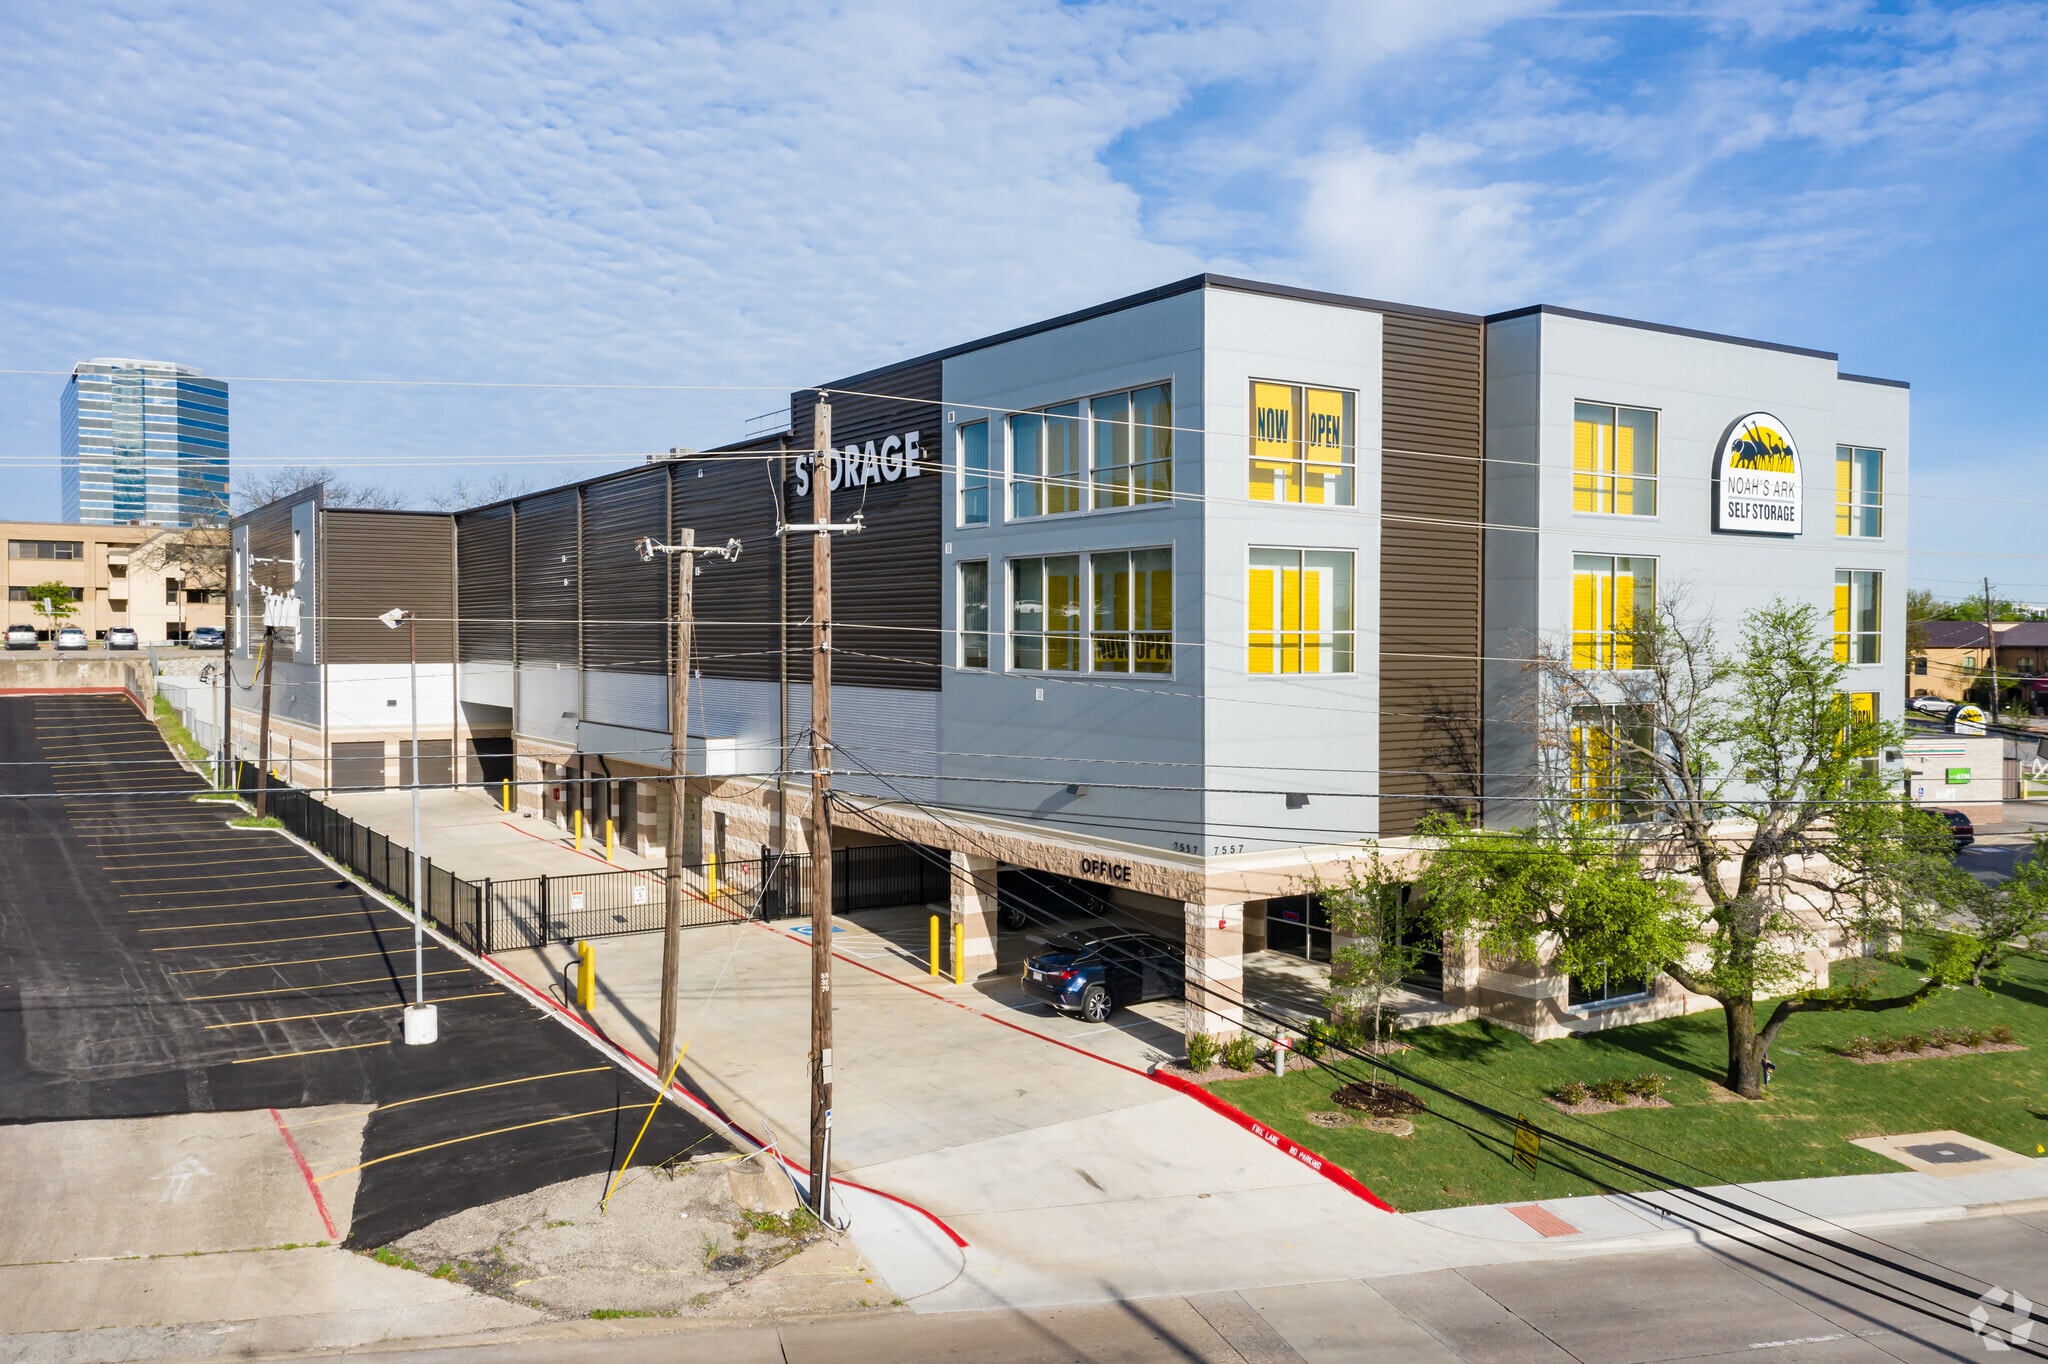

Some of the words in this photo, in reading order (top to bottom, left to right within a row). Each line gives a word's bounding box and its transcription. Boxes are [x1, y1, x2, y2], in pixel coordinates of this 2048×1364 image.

[1257, 407, 1289, 443] NOW
[1310, 412, 1340, 449] OPEN
[795, 430, 921, 497] SORAGE
[1728, 476, 1770, 497] NOAH'S
[1773, 480, 1795, 498] ARK
[1728, 501, 1750, 519] SELF
[1752, 503, 1795, 522] STORAGE
[1136, 633, 1172, 660] OPEN
[1173, 841, 1198, 855] 7557
[1213, 844, 1244, 856] 7557
[1081, 858, 1132, 882] OFFICE
[1251, 1123, 1265, 1136] FIRE
[1265, 1131, 1280, 1146] LANE
[1289, 1145, 1298, 1156] NO
[1299, 1152, 1322, 1170] PARKING
